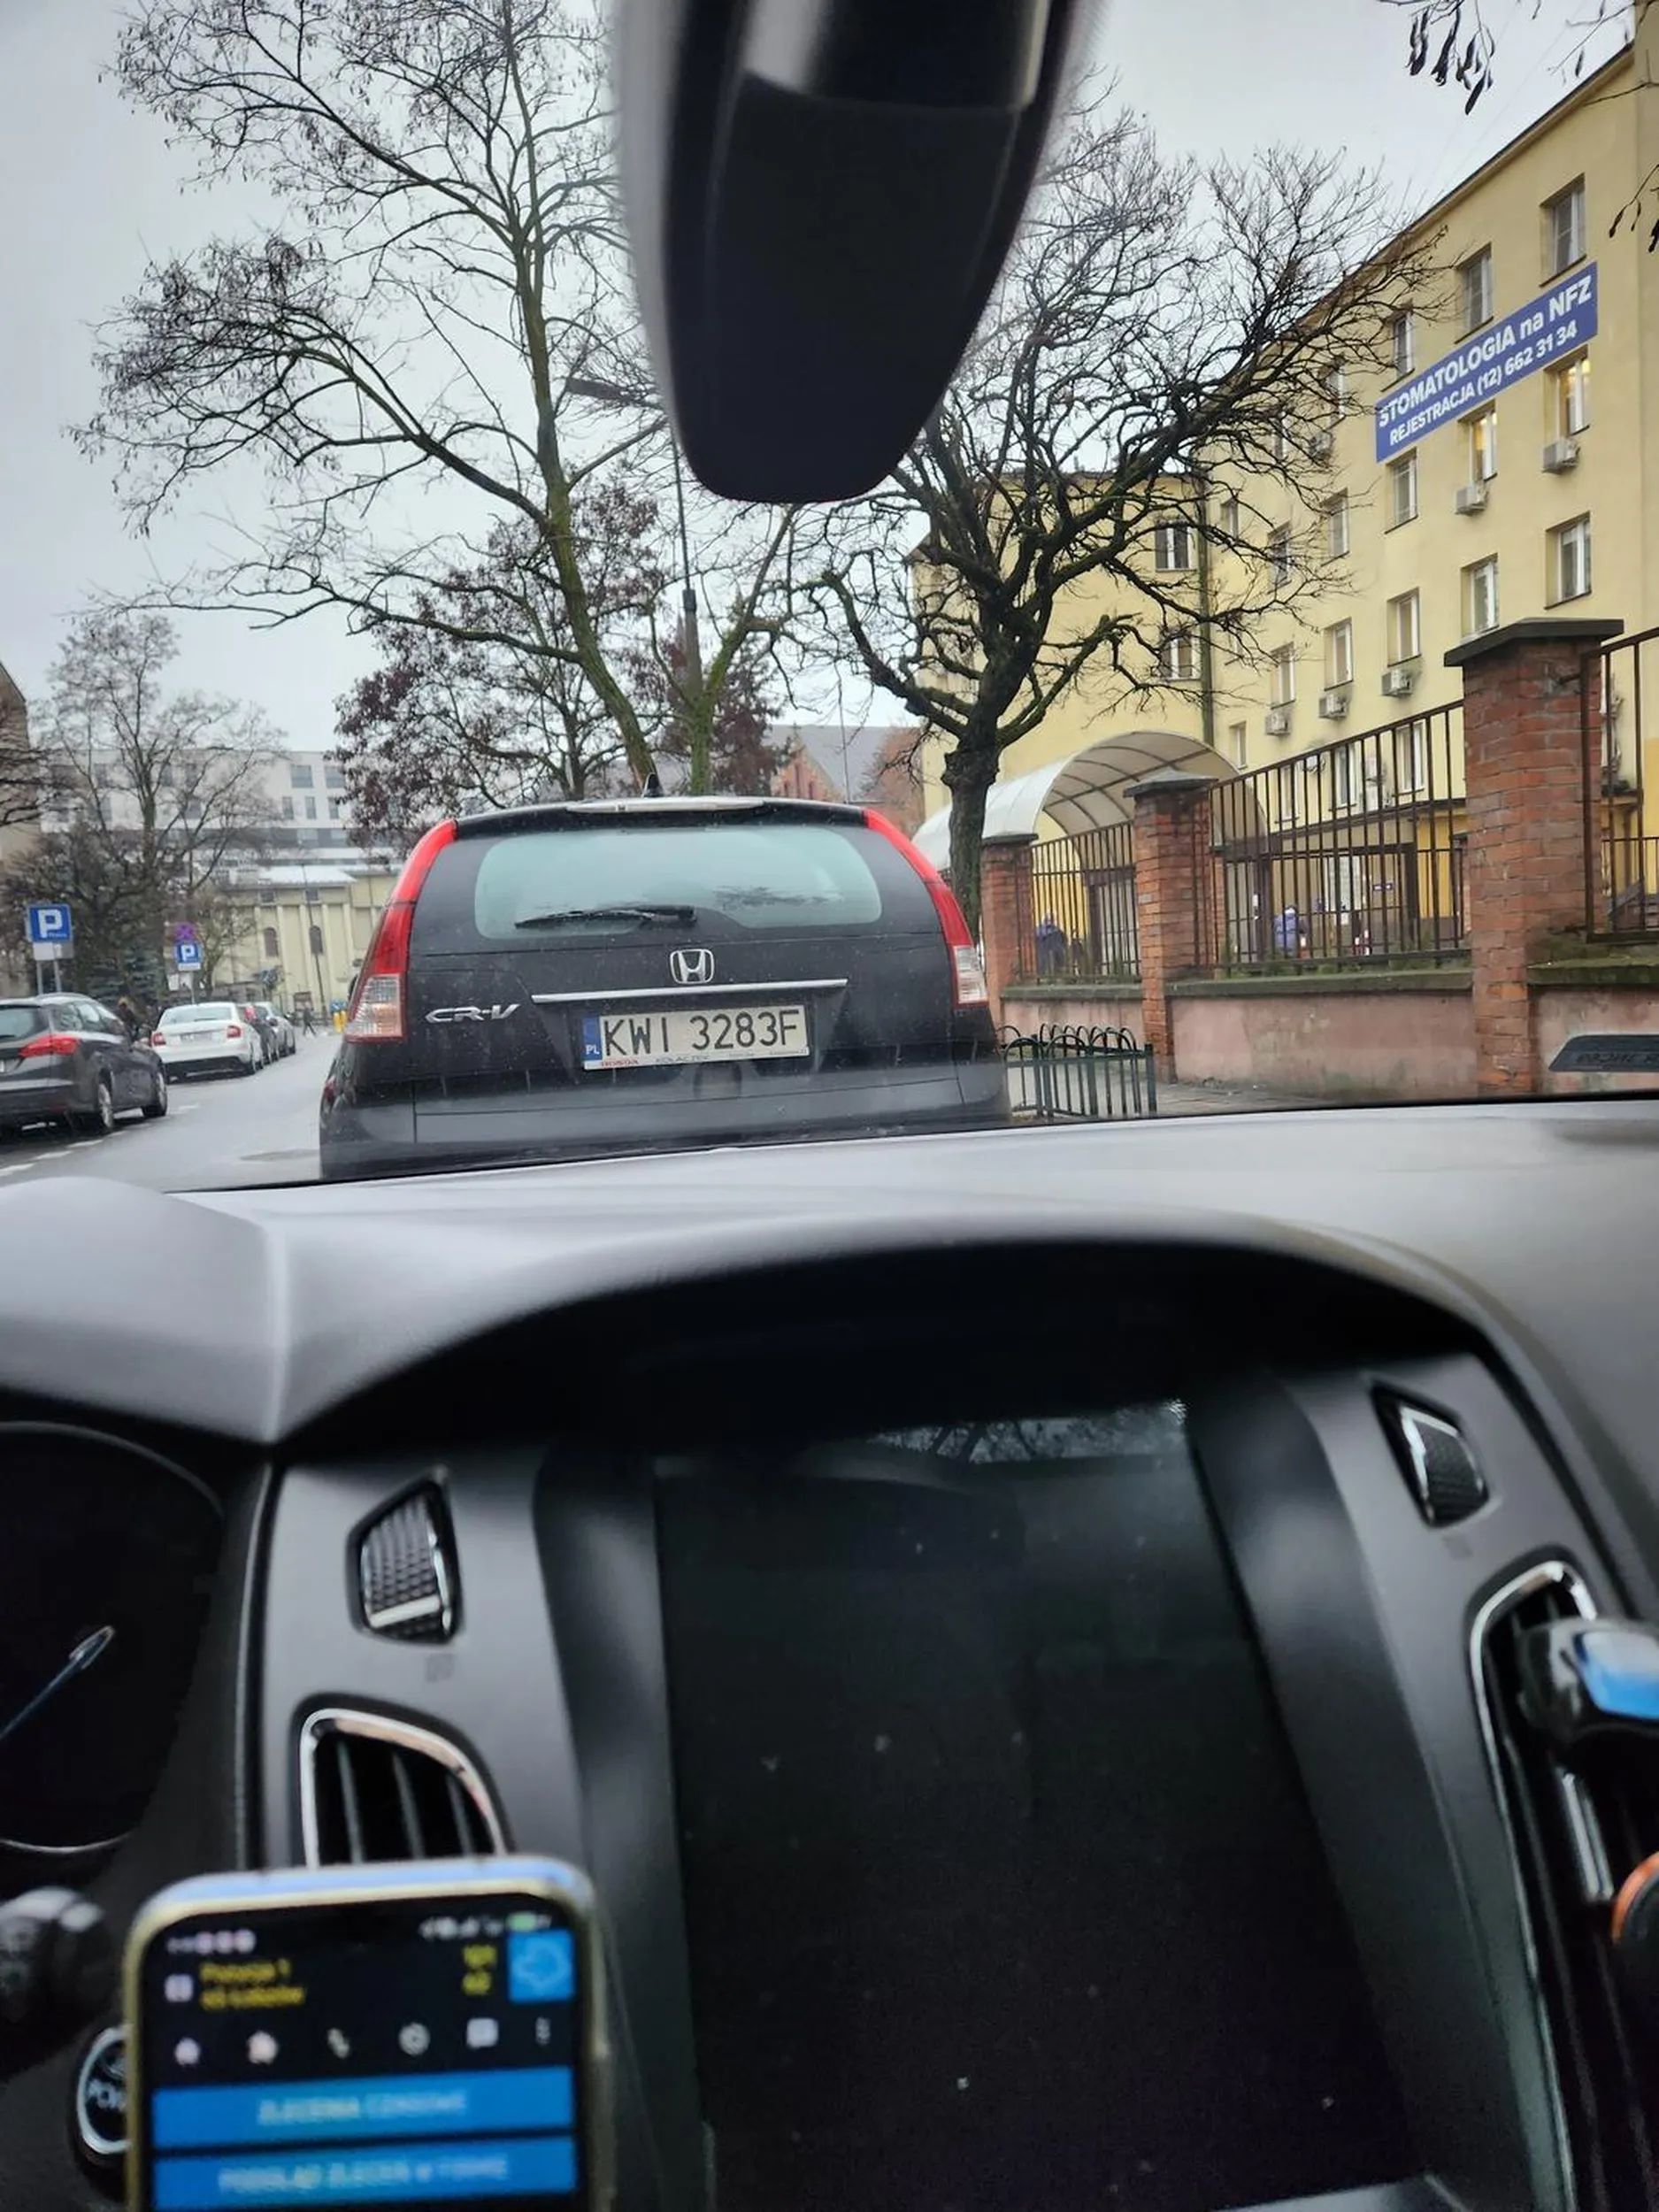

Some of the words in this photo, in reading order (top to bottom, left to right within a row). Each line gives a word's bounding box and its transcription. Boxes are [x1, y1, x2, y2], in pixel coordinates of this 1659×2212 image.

[1379, 326, 1516, 427] STOMATOLOGIA
[1520, 312, 1544, 341] na
[1548, 275, 1592, 322] NFZ
[1390, 382, 1476, 446] REJESTRACJA
[1477, 365, 1502, 396] (12)
[1505, 346, 1533, 376] 662
[1535, 333, 1553, 358] 31
[1556, 319, 1578, 346] 34
[38, 909, 62, 938] P
[180, 944, 195, 962] P
[426, 1003, 520, 1023] CR-V
[603, 1017, 669, 1056] KWI
[689, 1010, 799, 1050] 3283F
[586, 1045, 600, 1055] PL
